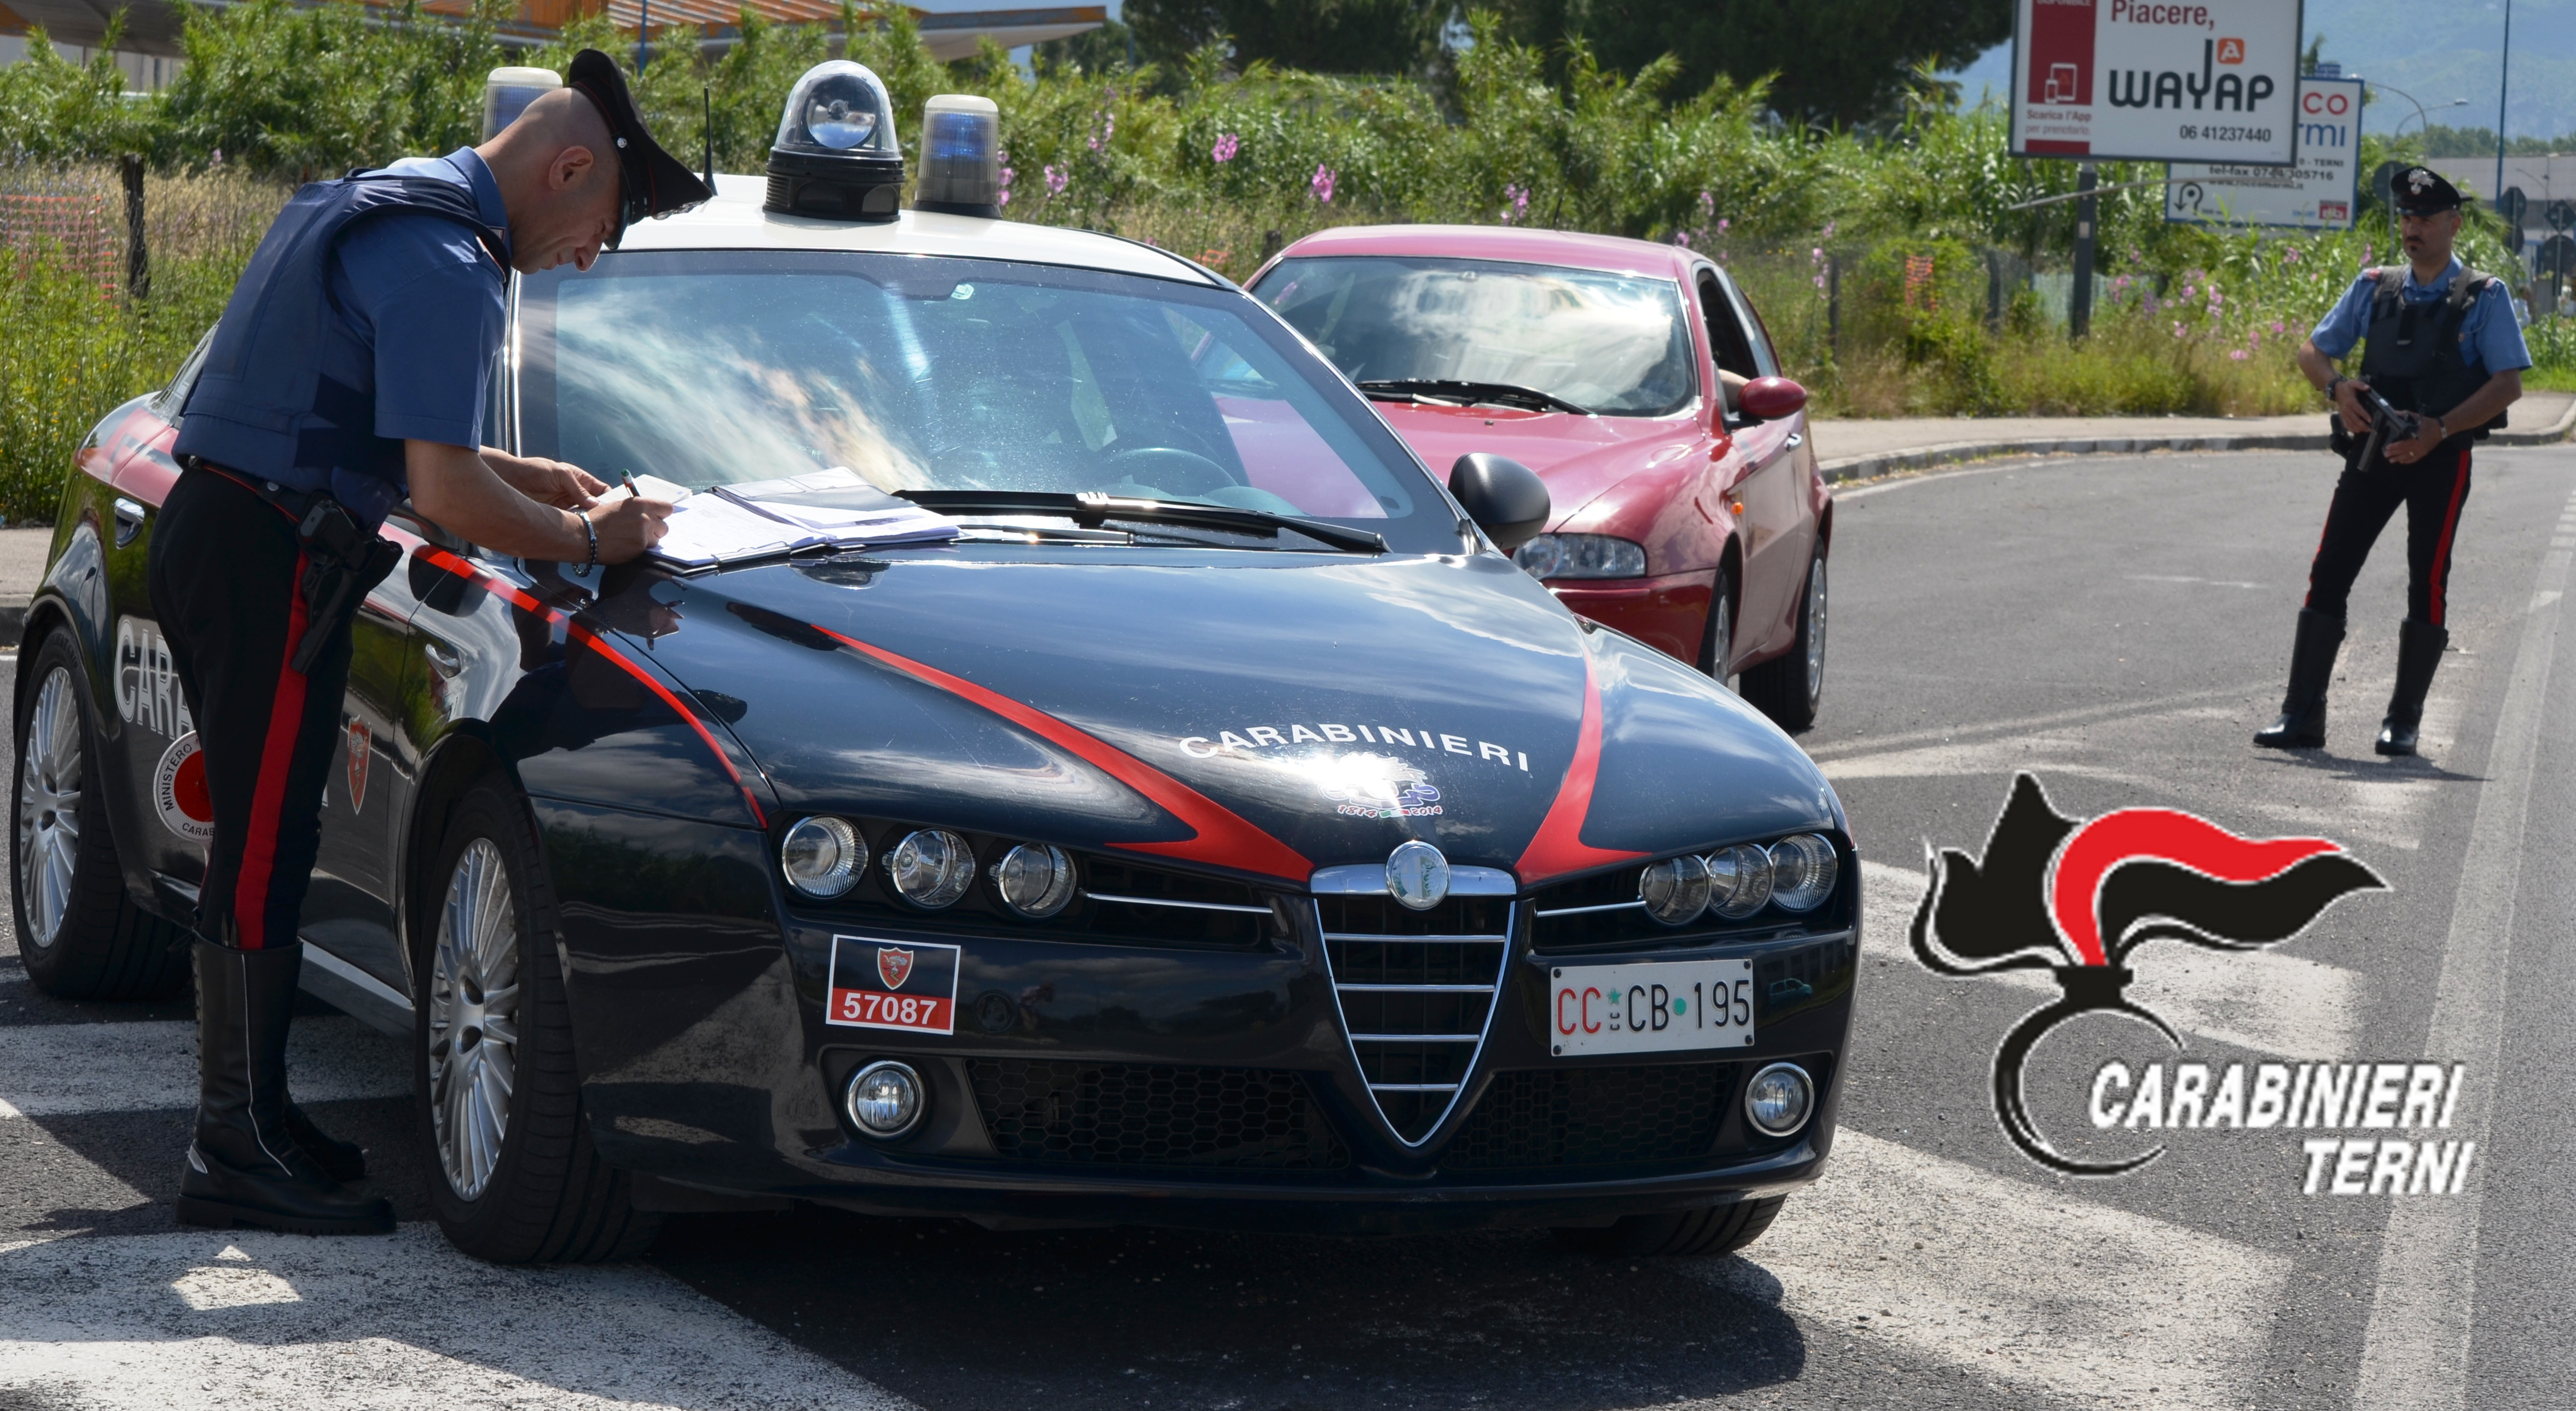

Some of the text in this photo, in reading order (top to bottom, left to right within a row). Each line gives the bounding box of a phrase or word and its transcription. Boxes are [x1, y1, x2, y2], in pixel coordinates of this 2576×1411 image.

[2110, 0, 2214, 30] Piacere,
[2180, 125, 2271, 142] 06 41237440
[2314, 158, 2344, 167] TERNI
[114, 619, 195, 740] CARA
[1180, 723, 1528, 772] CARABINIERI
[162, 744, 192, 811] MINISTERO
[1338, 804, 1443, 817] 1814 2014
[843, 992, 937, 1025] 57087
[1557, 986, 1602, 1035] CC
[1694, 979, 1750, 1029] 195
